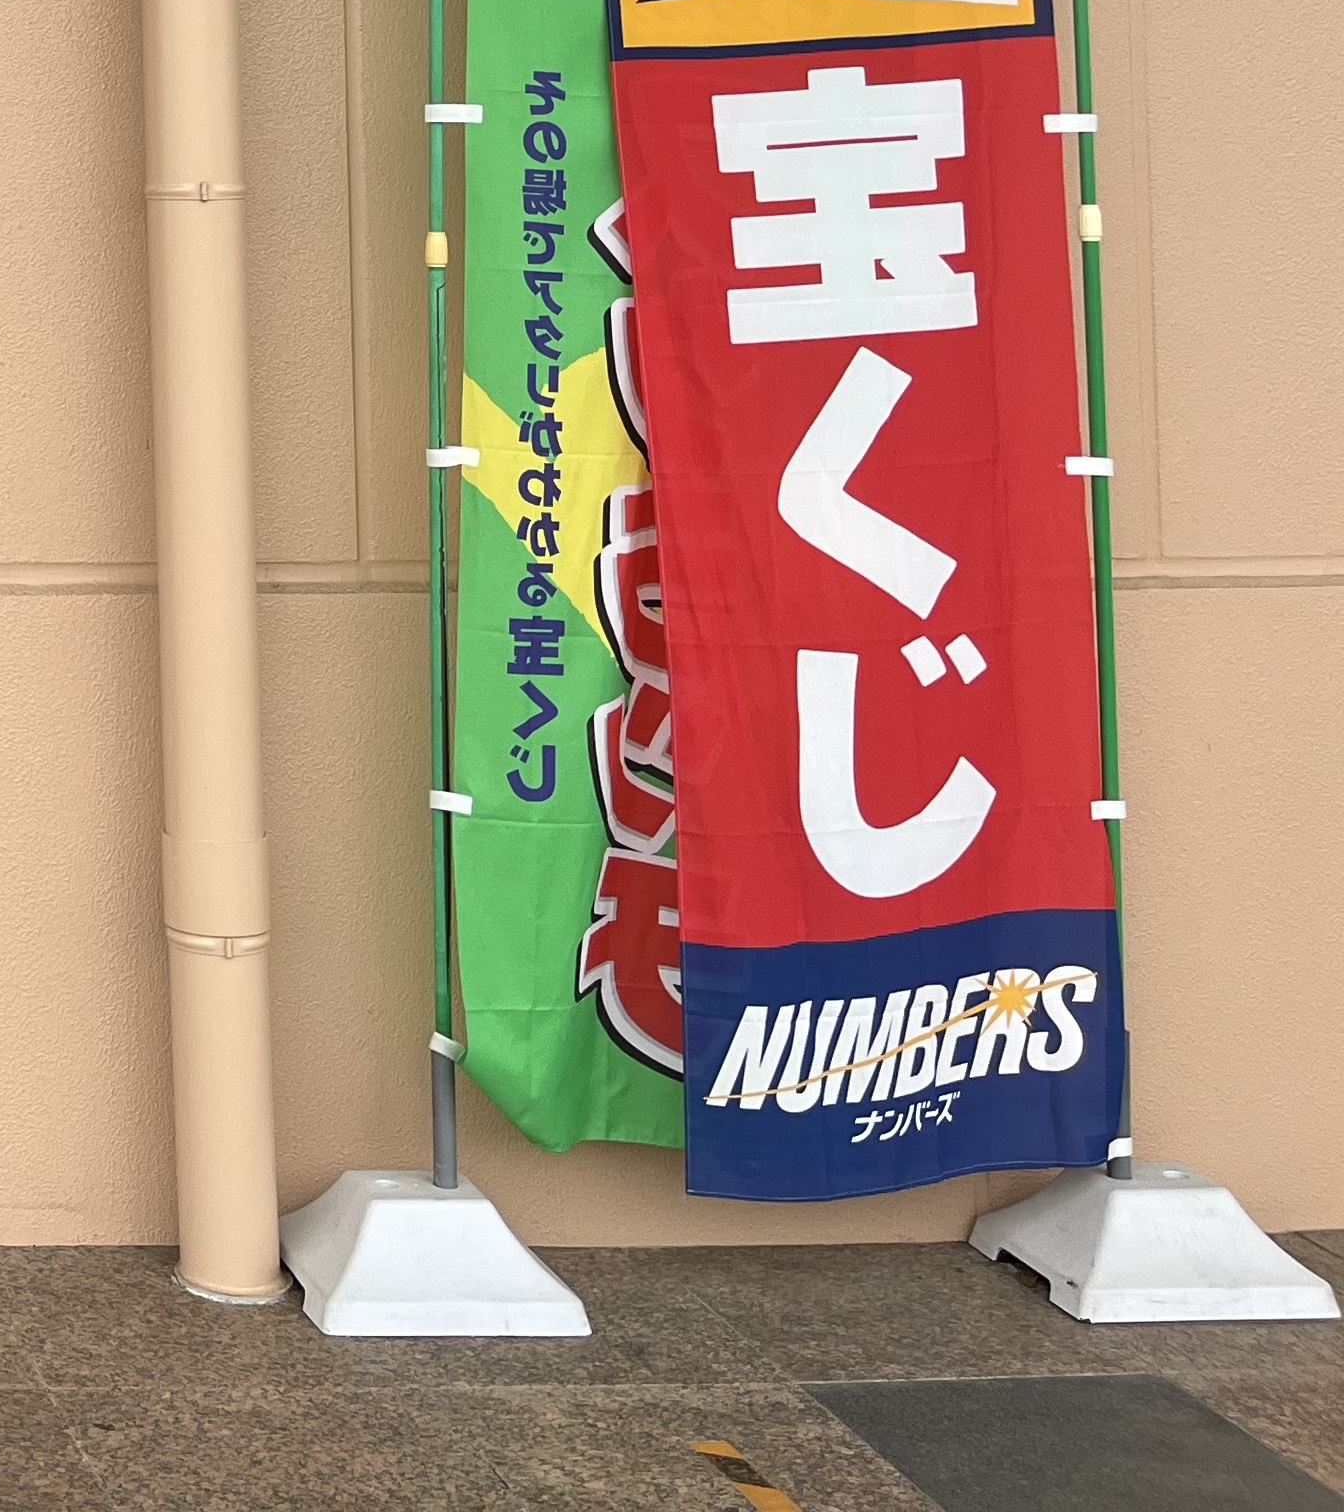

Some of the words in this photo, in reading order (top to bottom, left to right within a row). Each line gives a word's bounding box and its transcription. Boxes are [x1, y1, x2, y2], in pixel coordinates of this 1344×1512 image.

[712, 66, 999, 900] 宝くじ
[706, 964, 1098, 1115] NUMBERS
[850, 1091, 961, 1144] ナンバーズ
